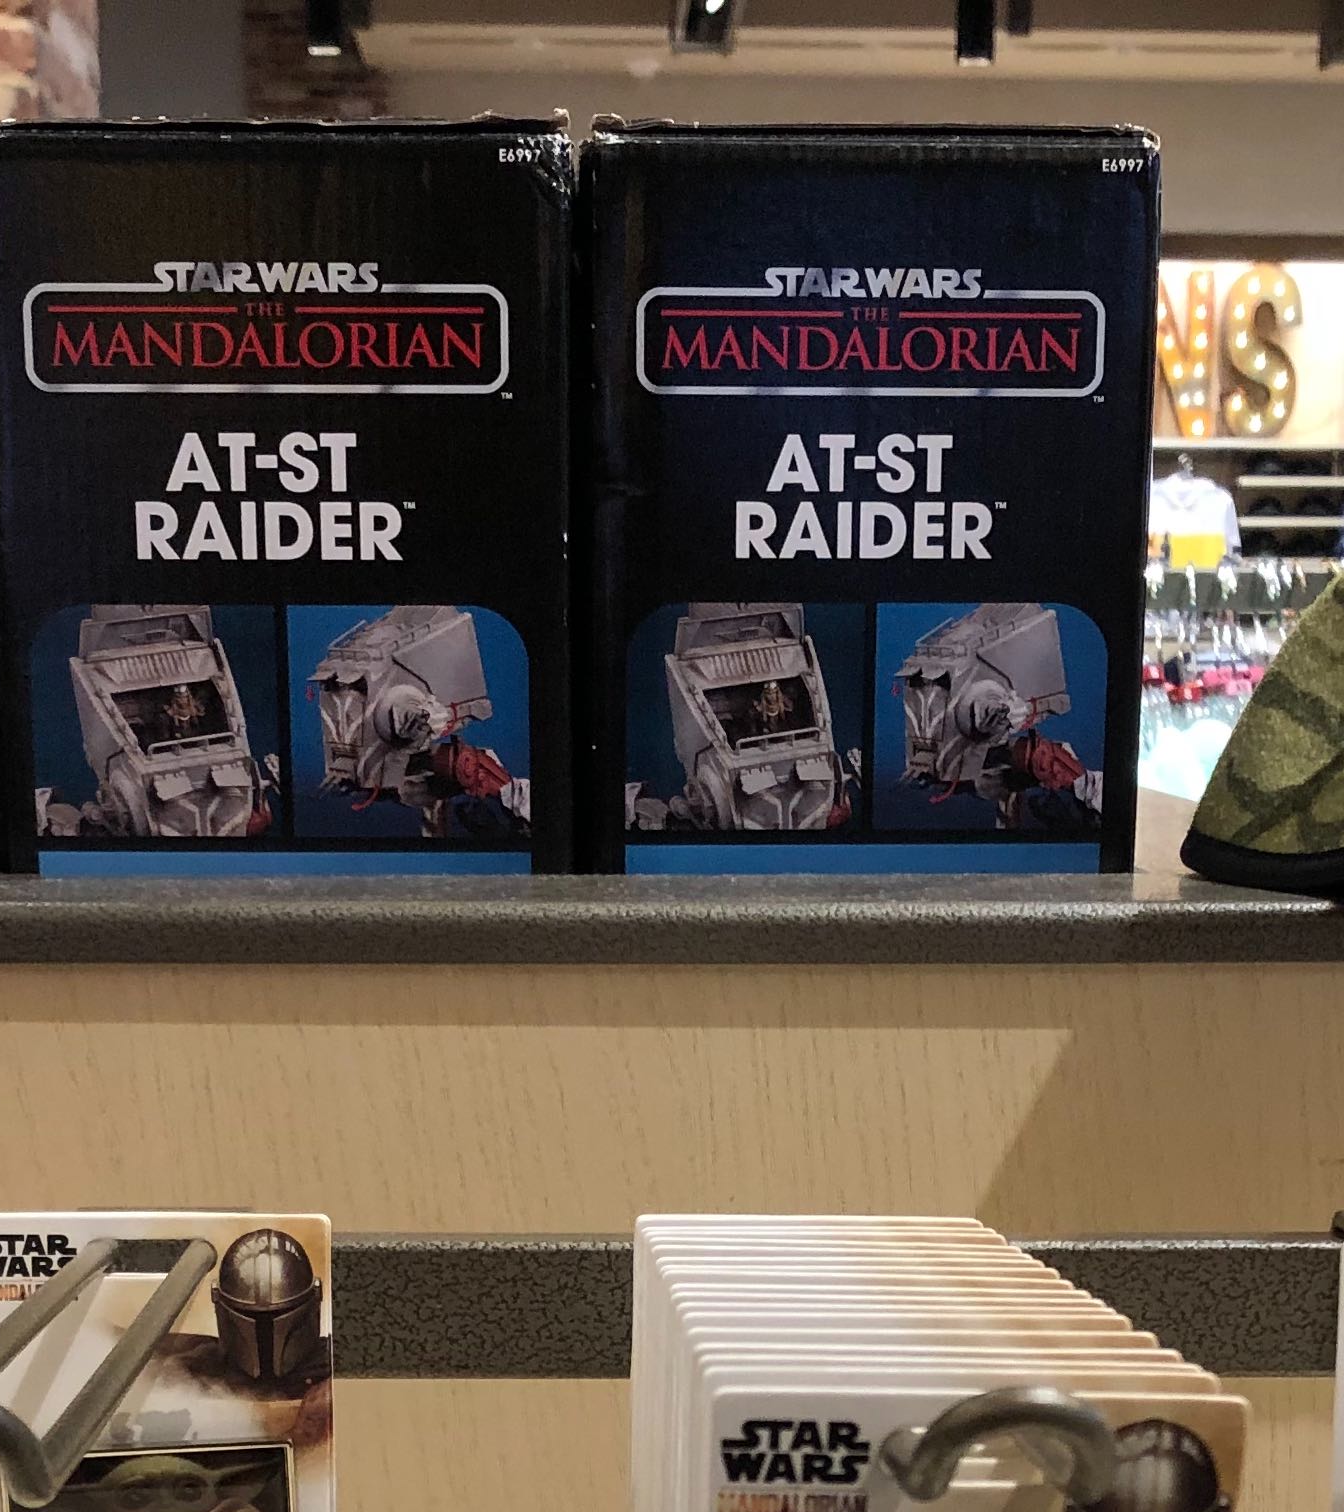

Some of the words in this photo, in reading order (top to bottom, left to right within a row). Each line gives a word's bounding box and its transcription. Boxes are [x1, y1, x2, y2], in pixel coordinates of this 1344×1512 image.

[499, 148, 541, 162] E6997
[1102, 158, 1144, 172] E6997
[155, 262, 259, 293] STAR
[256, 263, 378, 293] WARS
[765, 267, 867, 297] STAR
[864, 268, 982, 298] WARS
[245, 303, 285, 317] THE
[850, 307, 889, 321] THE
[52, 322, 484, 369] MANDALORIAN
[662, 324, 1080, 372] MANDALORIAN
[165, 431, 357, 493] AT-ST
[766, 433, 954, 493] AT-ST
[721, 1420, 870, 1452] STAR
[721, 1453, 869, 1484] WARS
